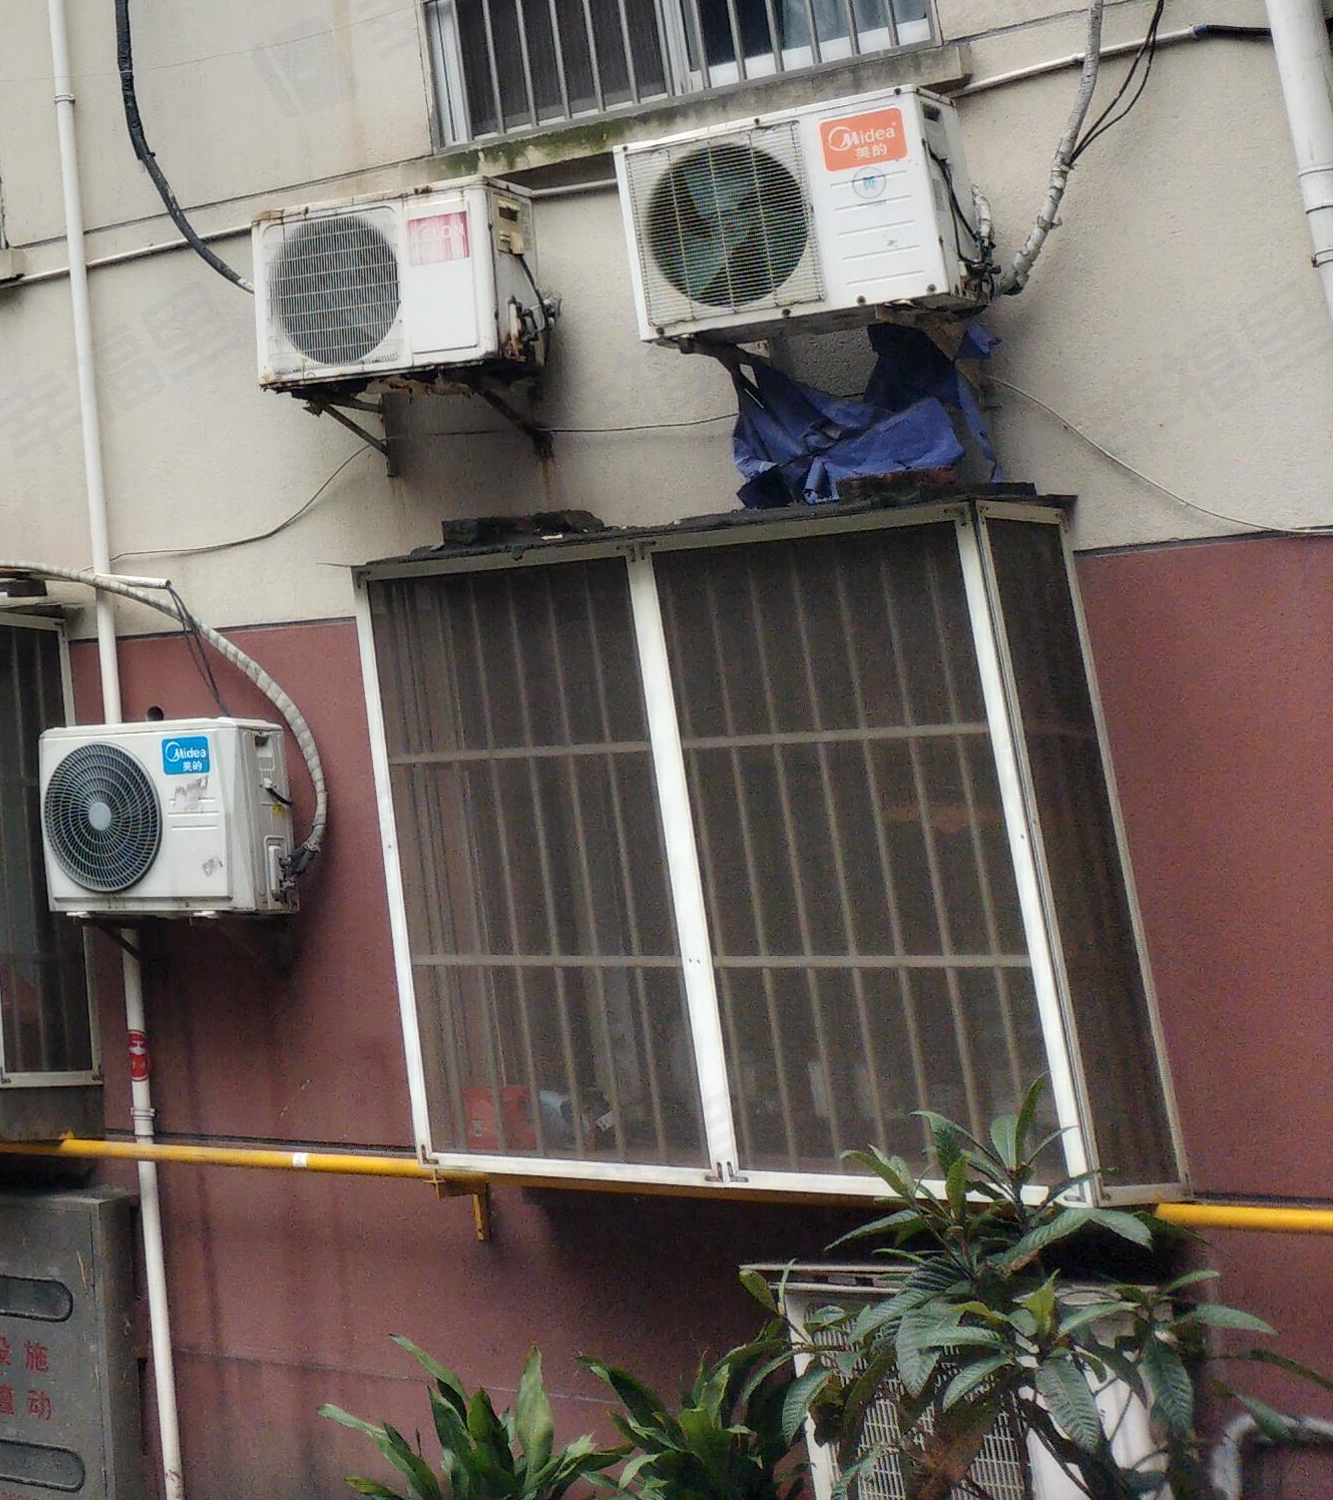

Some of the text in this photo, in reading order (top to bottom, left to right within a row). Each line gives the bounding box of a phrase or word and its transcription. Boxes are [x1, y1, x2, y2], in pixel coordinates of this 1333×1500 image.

[828, 126, 895, 152] Midea
[854, 143, 888, 160] 美的
[165, 741, 207, 763] Midea
[182, 761, 203, 772] 美的
